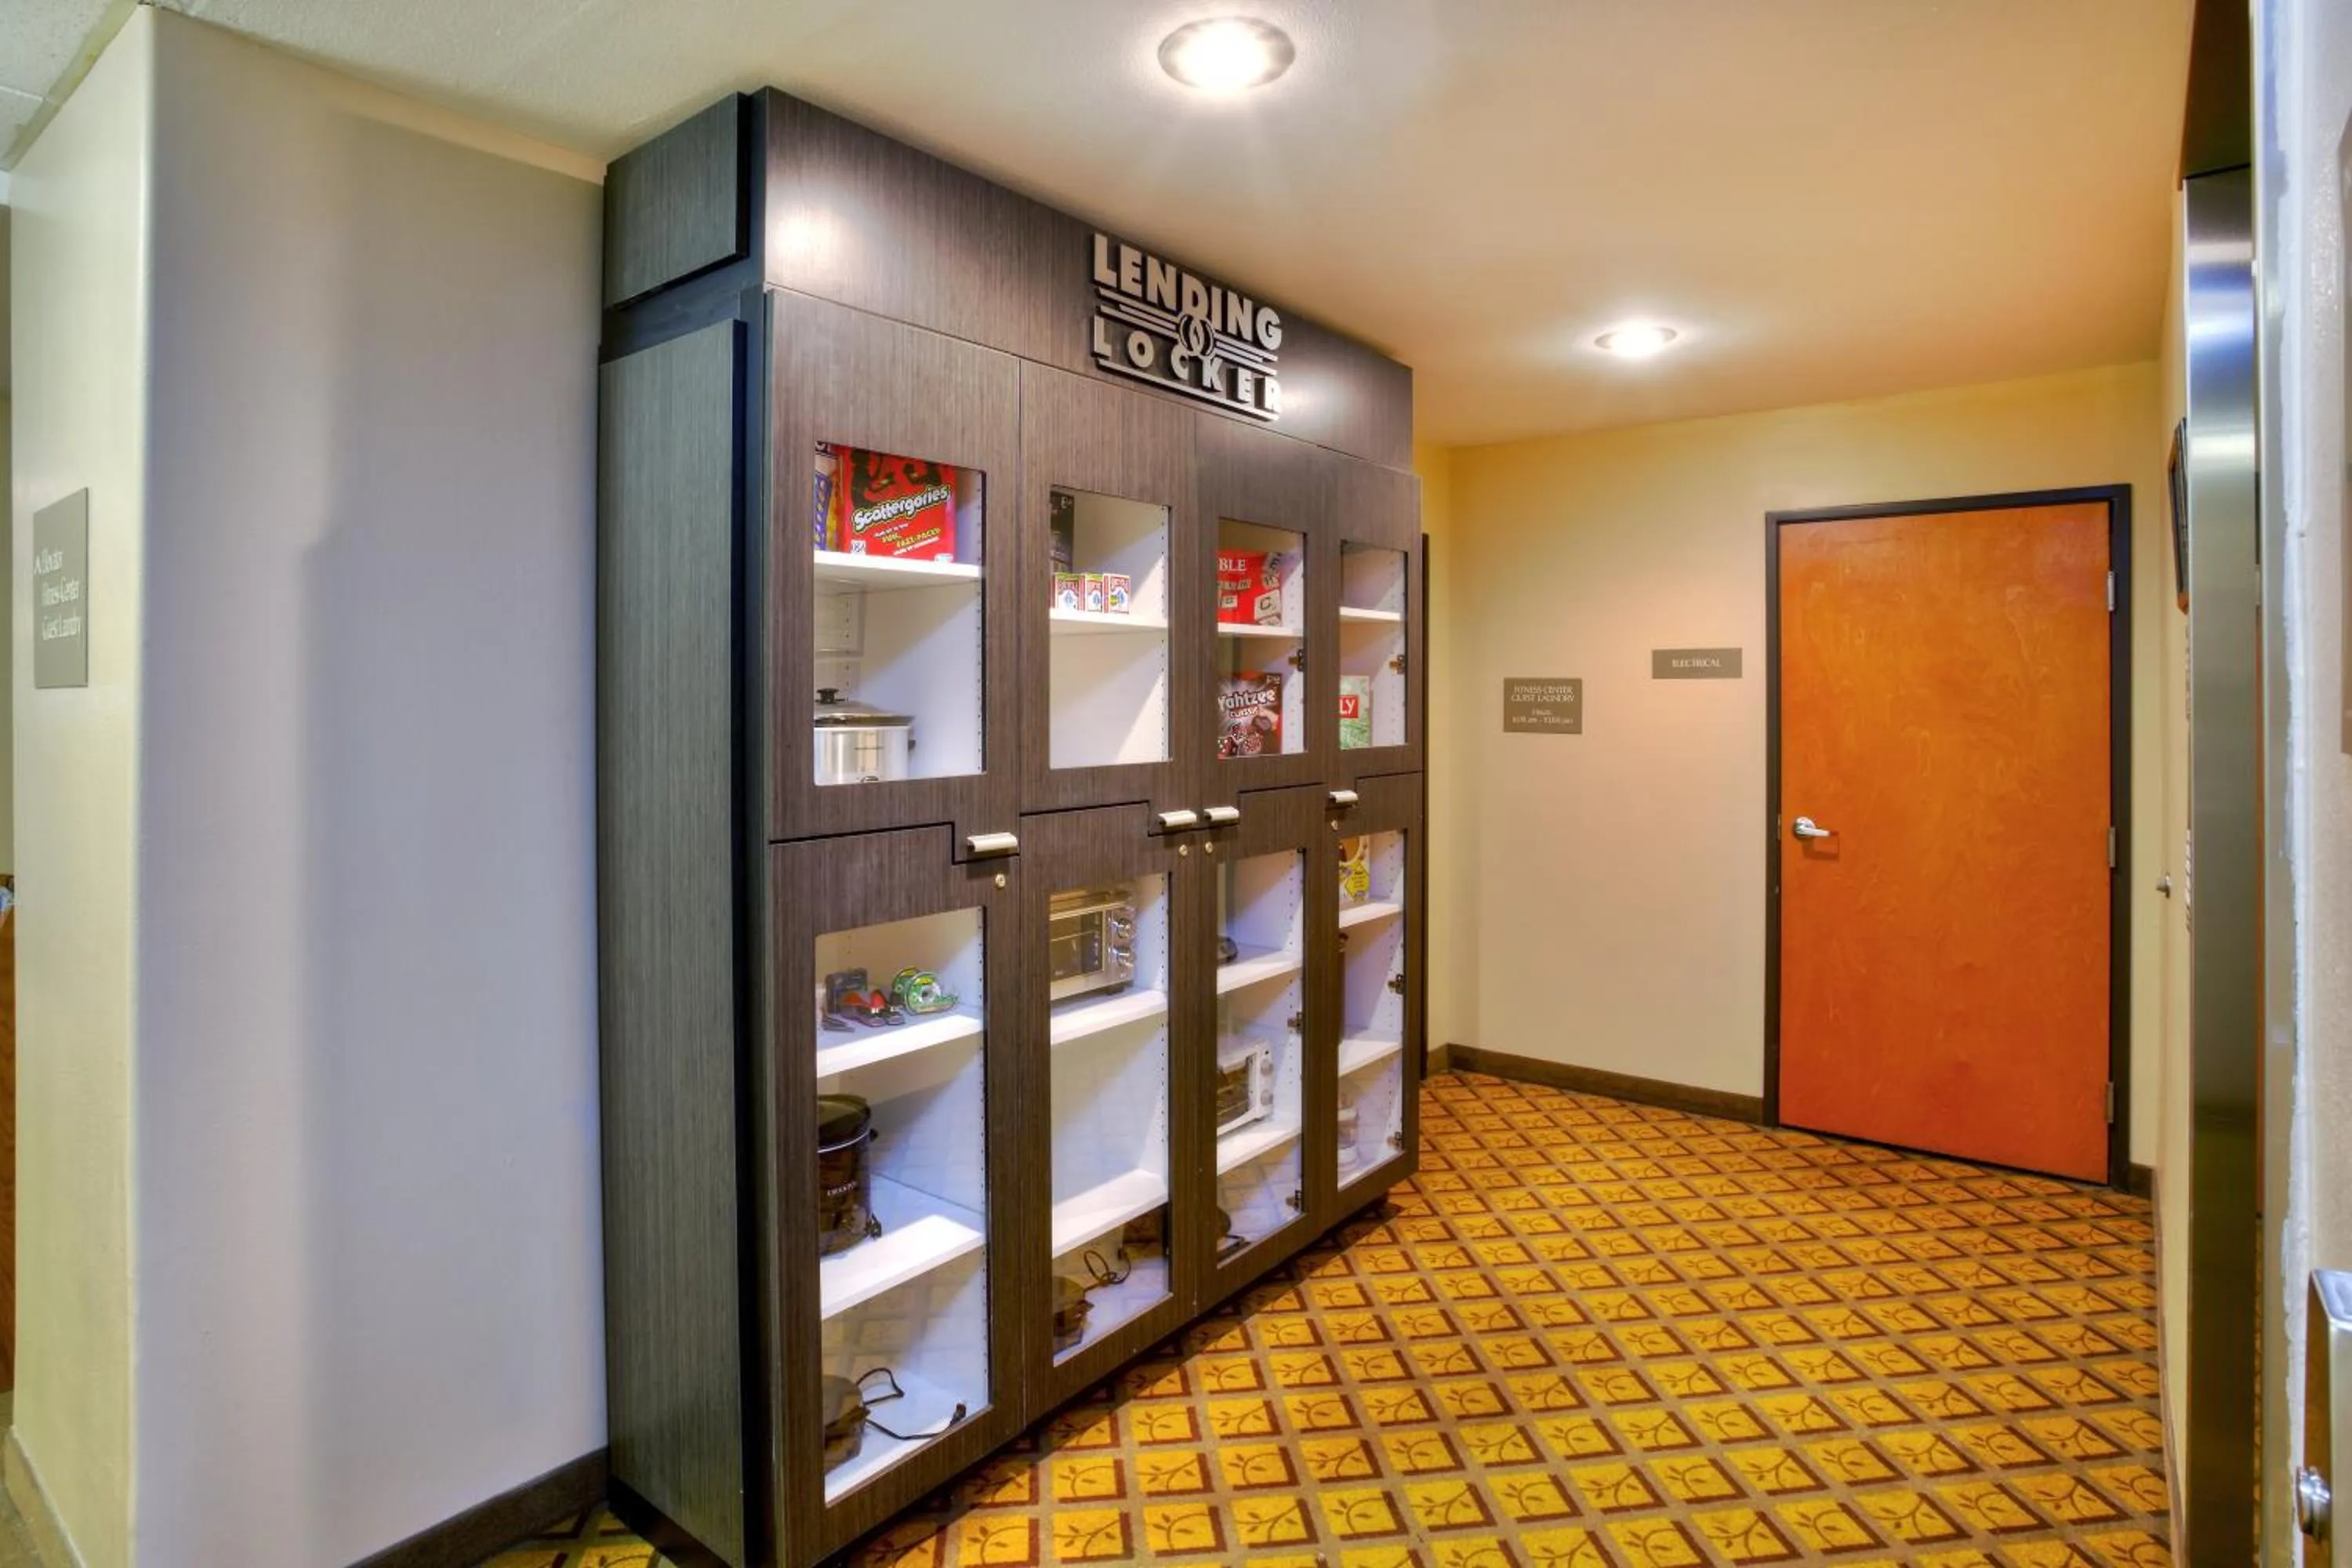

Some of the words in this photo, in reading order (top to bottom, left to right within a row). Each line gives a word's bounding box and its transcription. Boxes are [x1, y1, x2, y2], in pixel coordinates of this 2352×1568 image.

[1094, 232, 1283, 351] LENDING
[1093, 314, 1283, 413] LOCKER
[853, 486, 951, 531] Scattergories
[1671, 658, 1722, 668] ELECTRICAL
[1218, 690, 1276, 712] Yahtzee
